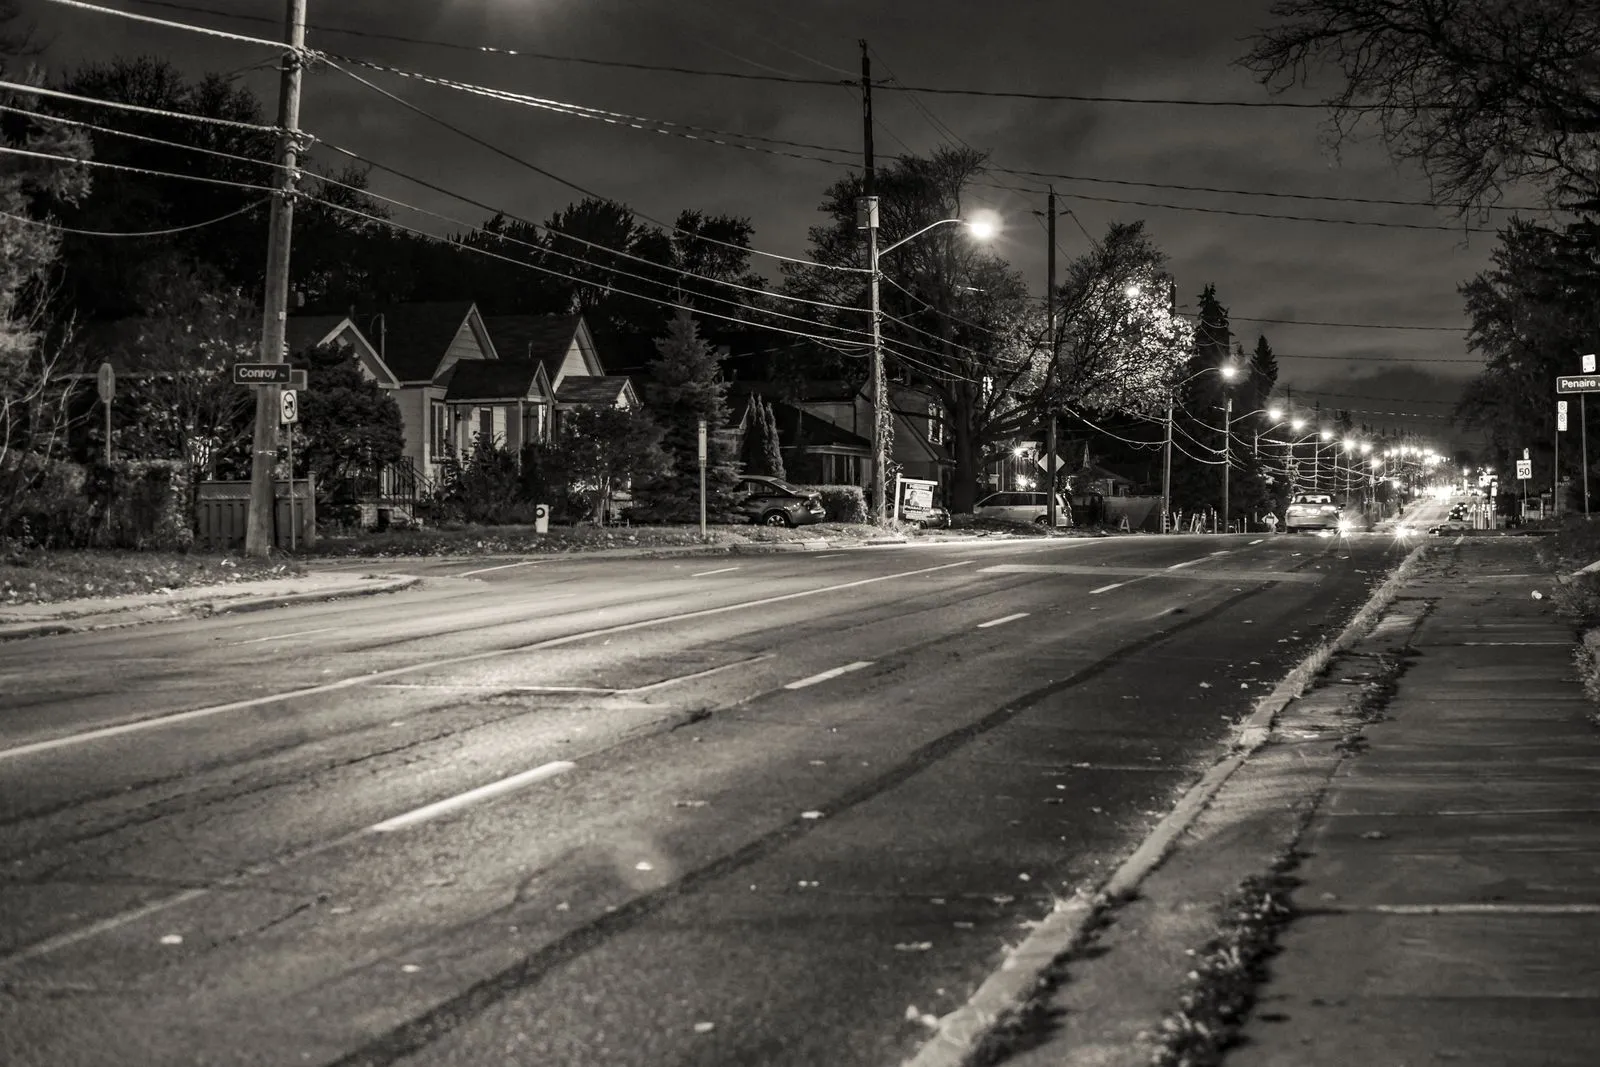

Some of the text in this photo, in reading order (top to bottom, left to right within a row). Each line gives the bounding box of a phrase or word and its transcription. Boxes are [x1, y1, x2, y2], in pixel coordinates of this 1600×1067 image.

[239, 368, 277, 379] Conroy
[1562, 379, 1596, 388] Penaire
[1519, 467, 1530, 476] 50
